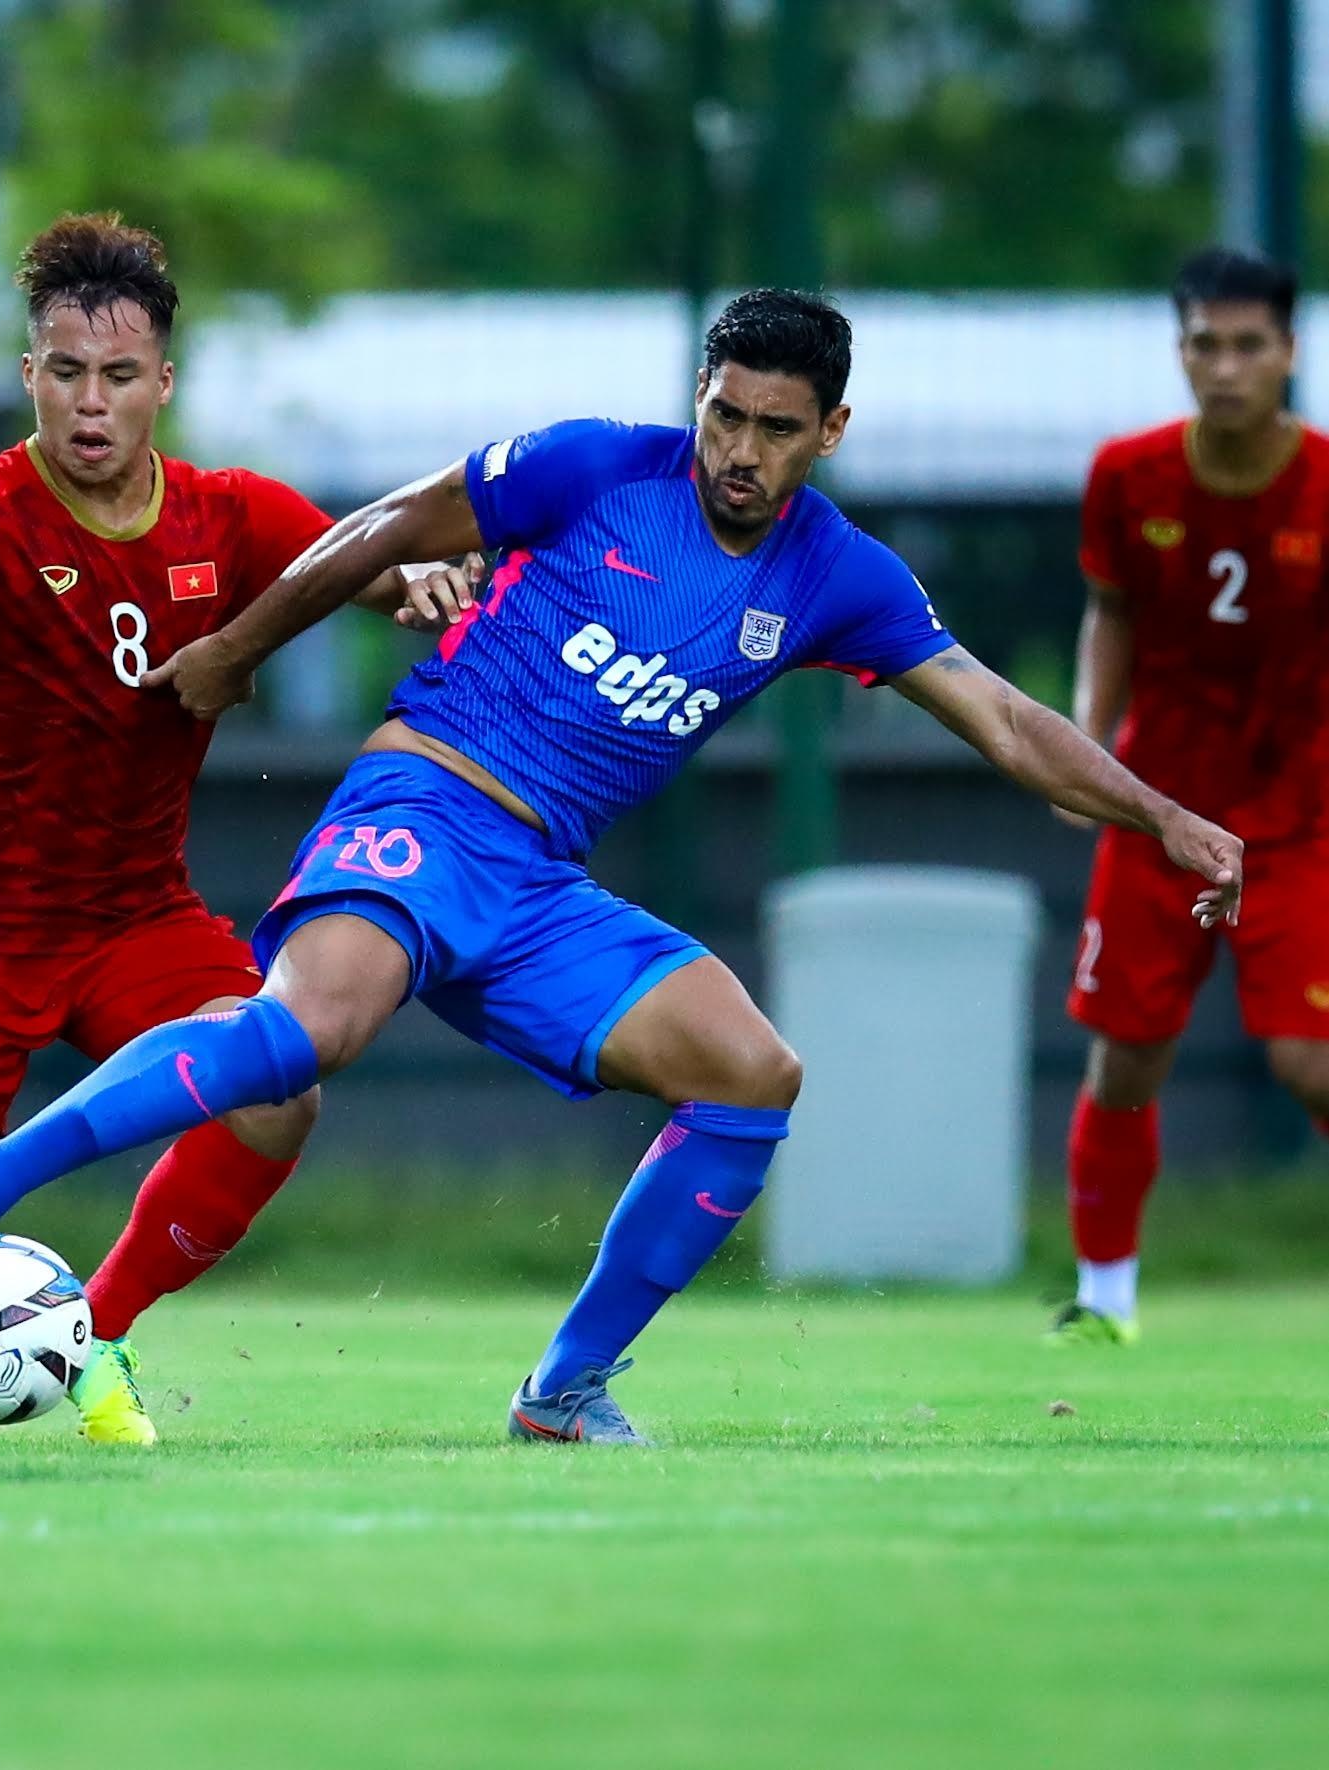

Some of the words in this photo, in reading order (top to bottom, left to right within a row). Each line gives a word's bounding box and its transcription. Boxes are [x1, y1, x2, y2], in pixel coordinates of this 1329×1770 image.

[1208, 548, 1249, 624] 2
[110, 602, 148, 688] 8
[561, 622, 721, 736] edps
[1075, 917, 1102, 993] 2
